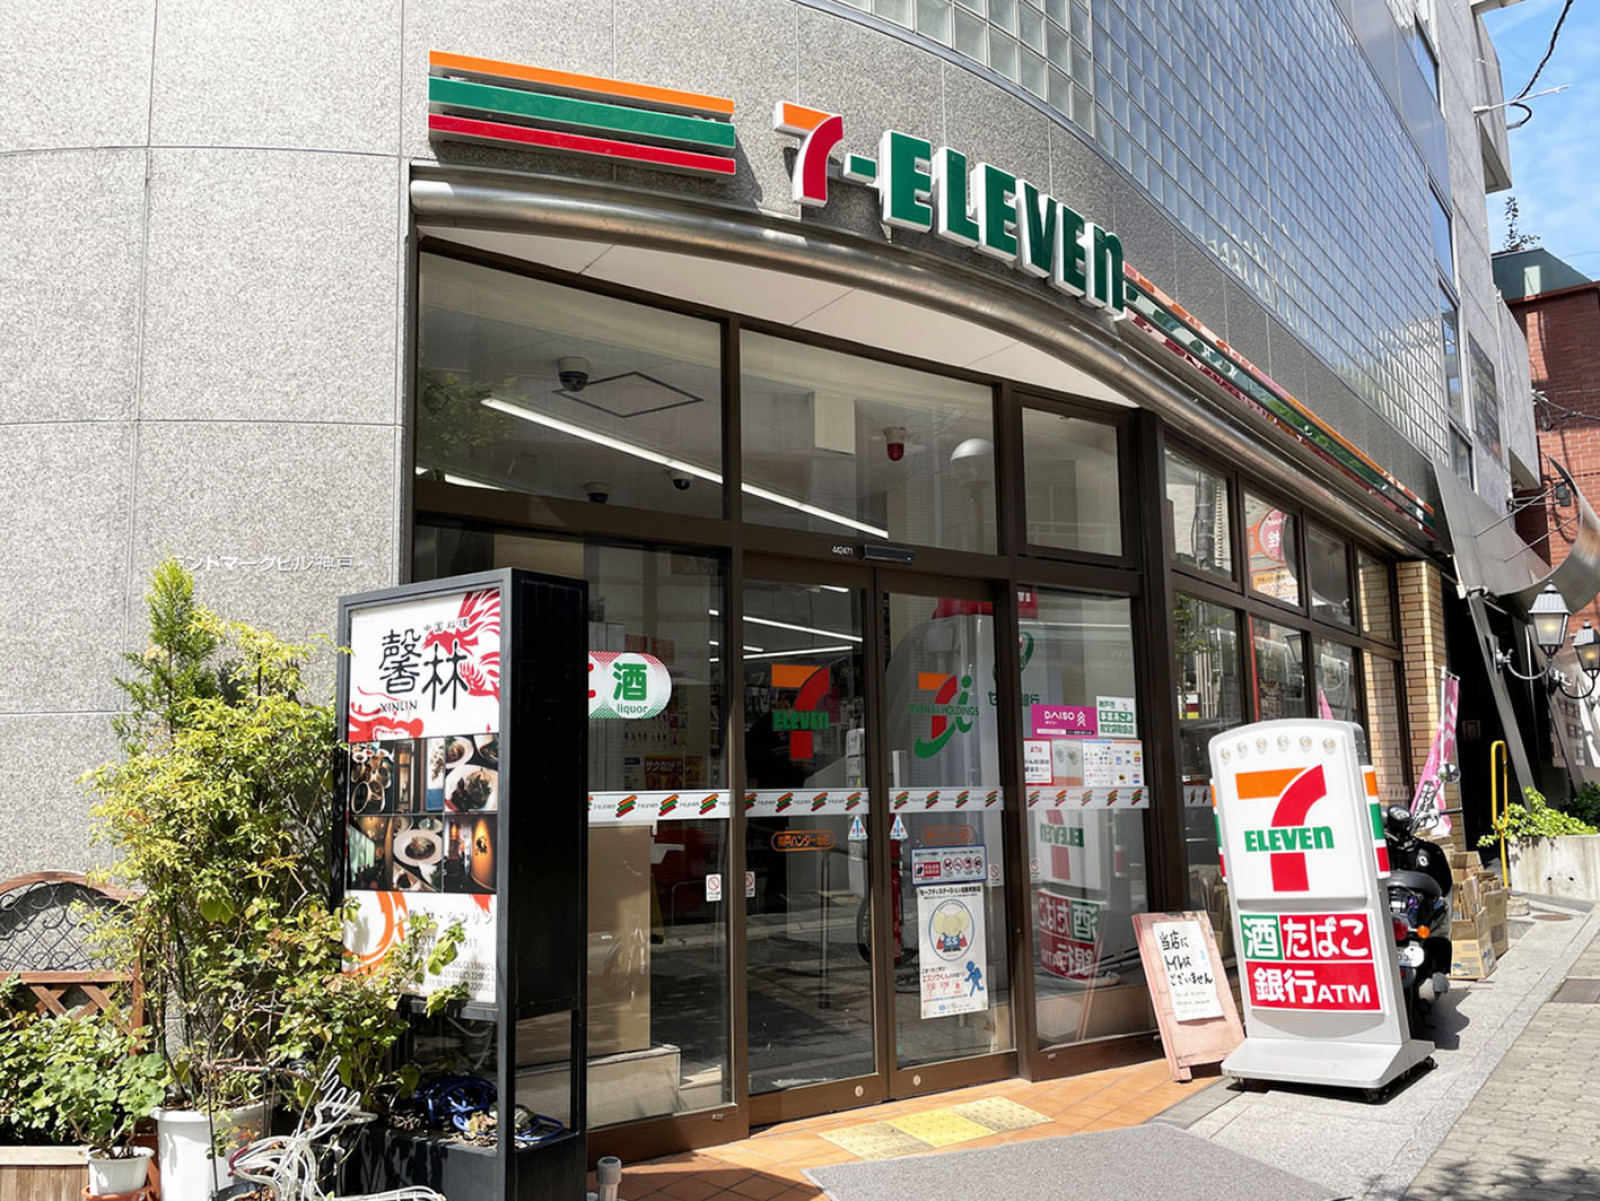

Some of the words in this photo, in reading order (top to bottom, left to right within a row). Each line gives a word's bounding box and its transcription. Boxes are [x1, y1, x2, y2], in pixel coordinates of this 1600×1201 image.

[612, 662, 647, 701] 酒
[380, 700, 418, 714] XINLIN
[617, 703, 648, 714] liquor
[1044, 710, 1075, 721] DAISO
[945, 937, 958, 946] SS
[1159, 929, 1190, 951] 当店に
[1243, 918, 1279, 957] 酒
[1282, 916, 1369, 959] たばこ
[1164, 955, 1192, 972] トイレは
[1170, 972, 1213, 987] ございません
